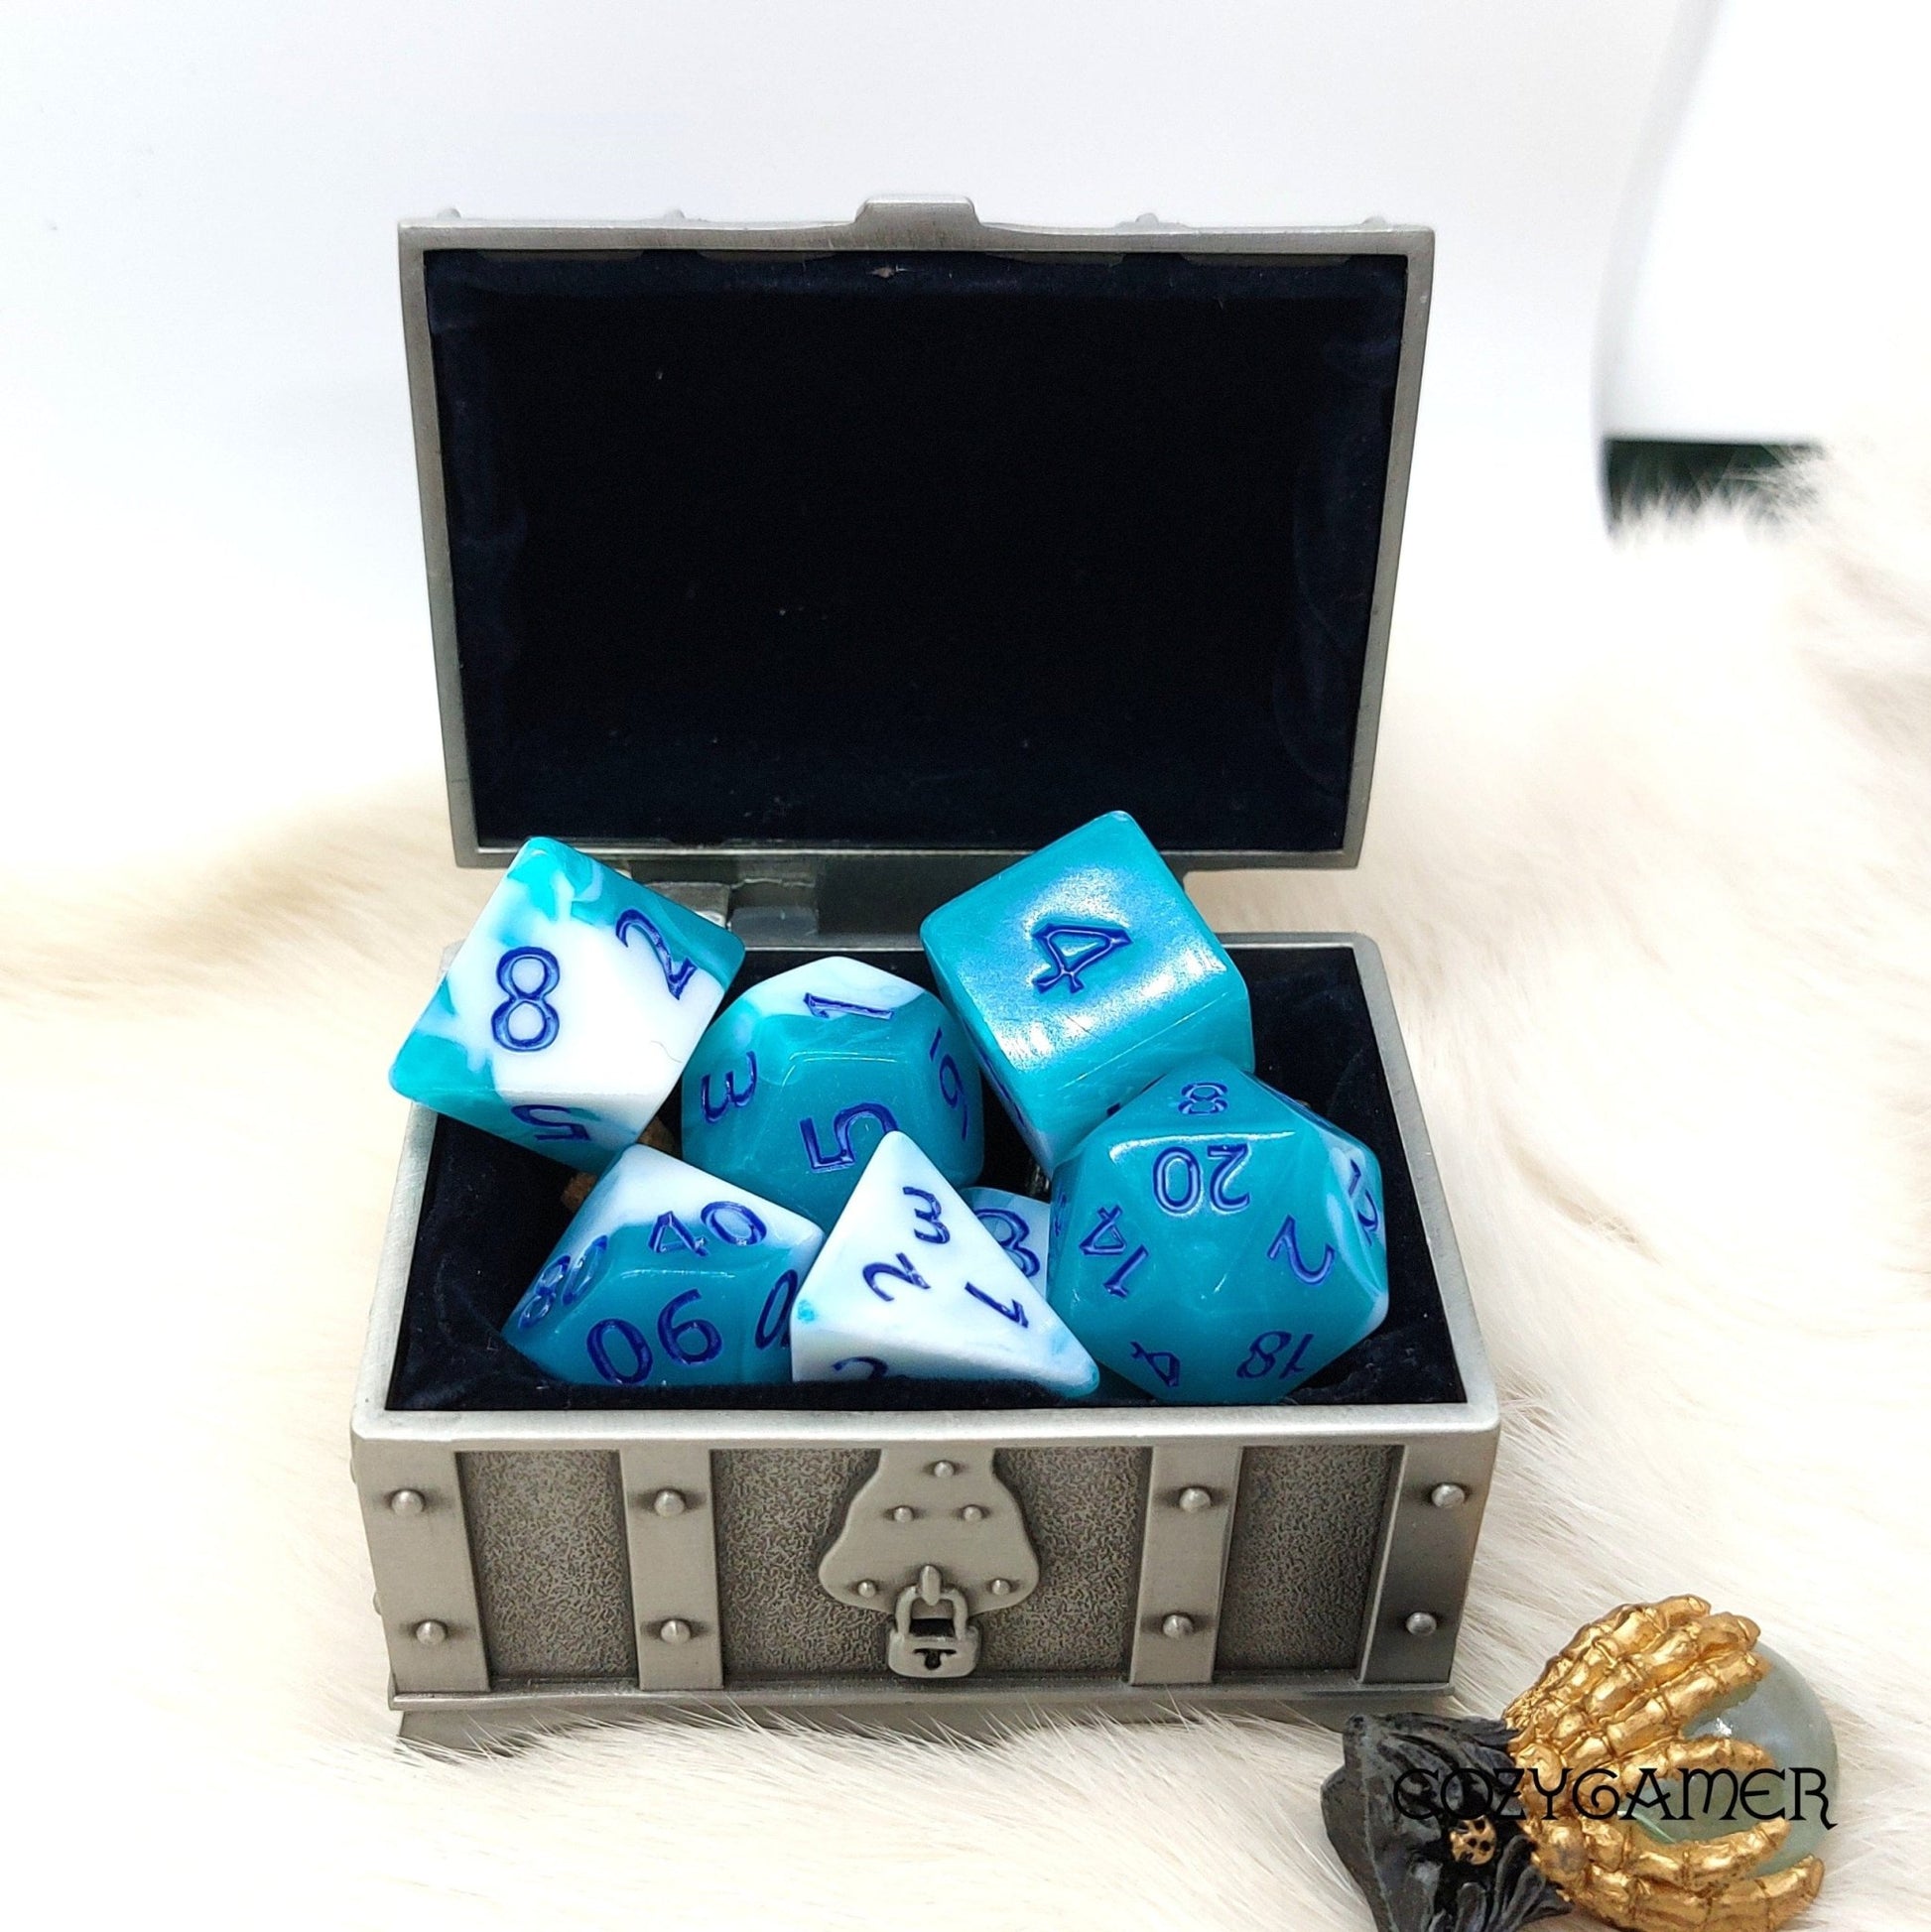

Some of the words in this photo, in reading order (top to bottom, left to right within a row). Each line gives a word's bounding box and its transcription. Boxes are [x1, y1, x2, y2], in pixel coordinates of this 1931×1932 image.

[615, 908, 699, 1000] 2
[1032, 923, 1133, 994] 4
[491, 947, 560, 1052] 8
[803, 992, 894, 1020] 1
[701, 1051, 757, 1124] 3
[1178, 1081, 1228, 1115] 8
[510, 1104, 598, 1142] 5
[799, 1102, 899, 1172] 5
[1153, 1143, 1251, 1215] 20
[648, 1201, 767, 1256] 40
[902, 1186, 951, 1244] 3
[862, 1252, 931, 1302] 2
[1079, 1205, 1149, 1298] 14
[1267, 1215, 1335, 1285] 2
[964, 1281, 1029, 1328] 1
[1130, 1342, 1181, 1387] 4
[1236, 1331, 1314, 1379] 18
